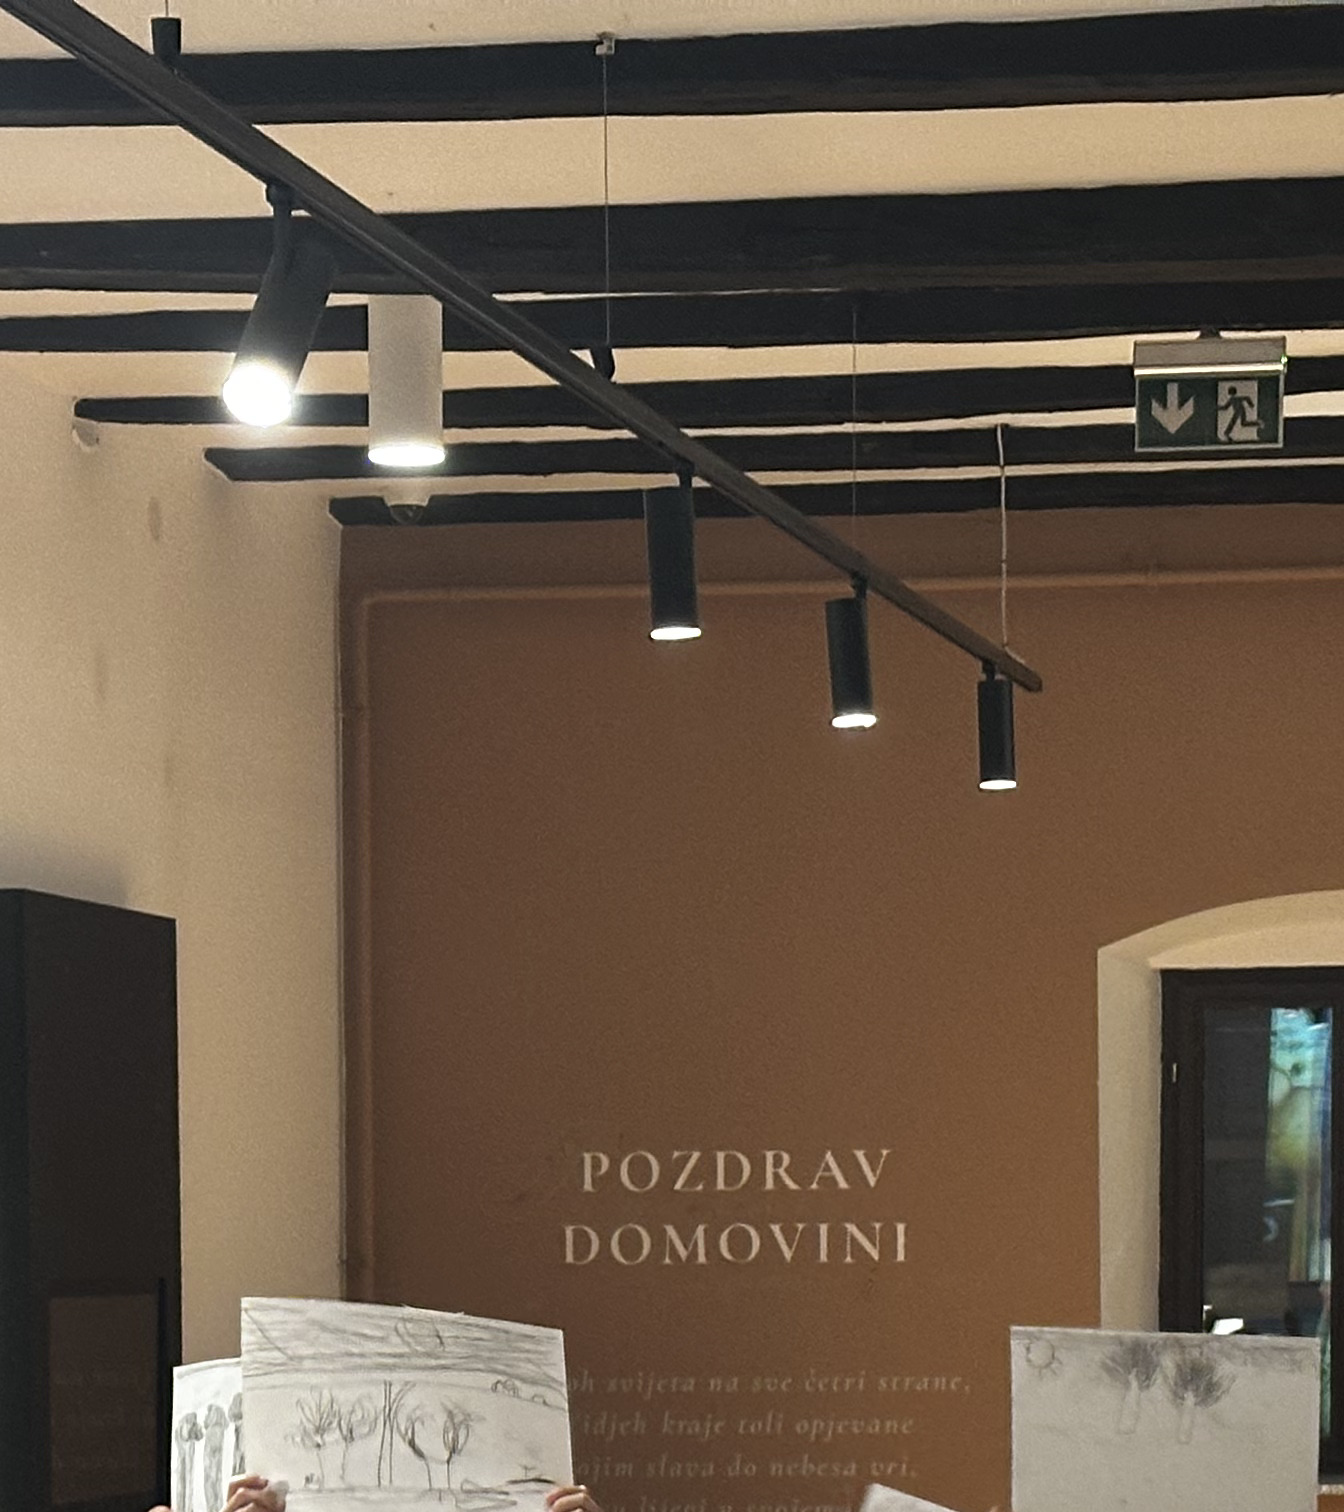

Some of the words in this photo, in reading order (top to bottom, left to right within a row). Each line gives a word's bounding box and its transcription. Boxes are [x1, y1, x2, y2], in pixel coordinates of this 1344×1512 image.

[581, 1148, 892, 1193] POZDRAV
[562, 1221, 908, 1266] DOMOVINI
[708, 1376, 739, 1393] na
[752, 1376, 793, 1393] sve
[581, 1410, 647, 1441] idjeh
[727, 1452, 758, 1477] do
